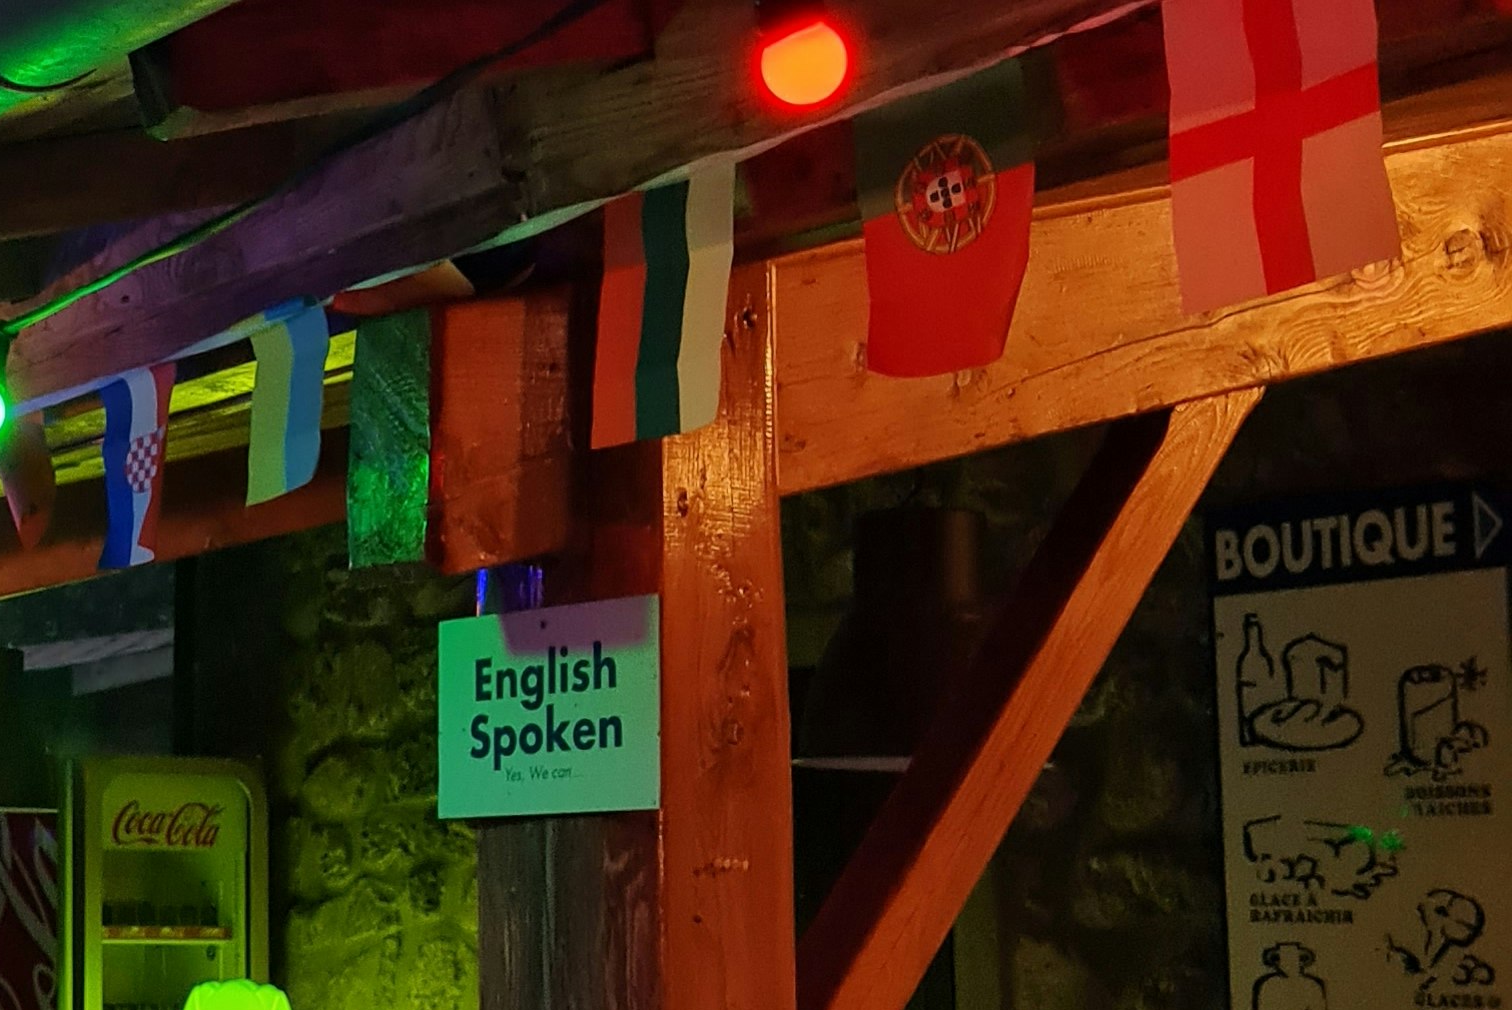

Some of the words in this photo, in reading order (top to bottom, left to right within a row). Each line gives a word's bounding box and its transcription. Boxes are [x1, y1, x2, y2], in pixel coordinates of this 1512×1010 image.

[1215, 501, 1457, 581] BOUTIQUE
[476, 641, 617, 710] English
[470, 703, 623, 771] Spoken
[530, 765, 549, 780] We
[112, 799, 222, 847] Coca-Cola
